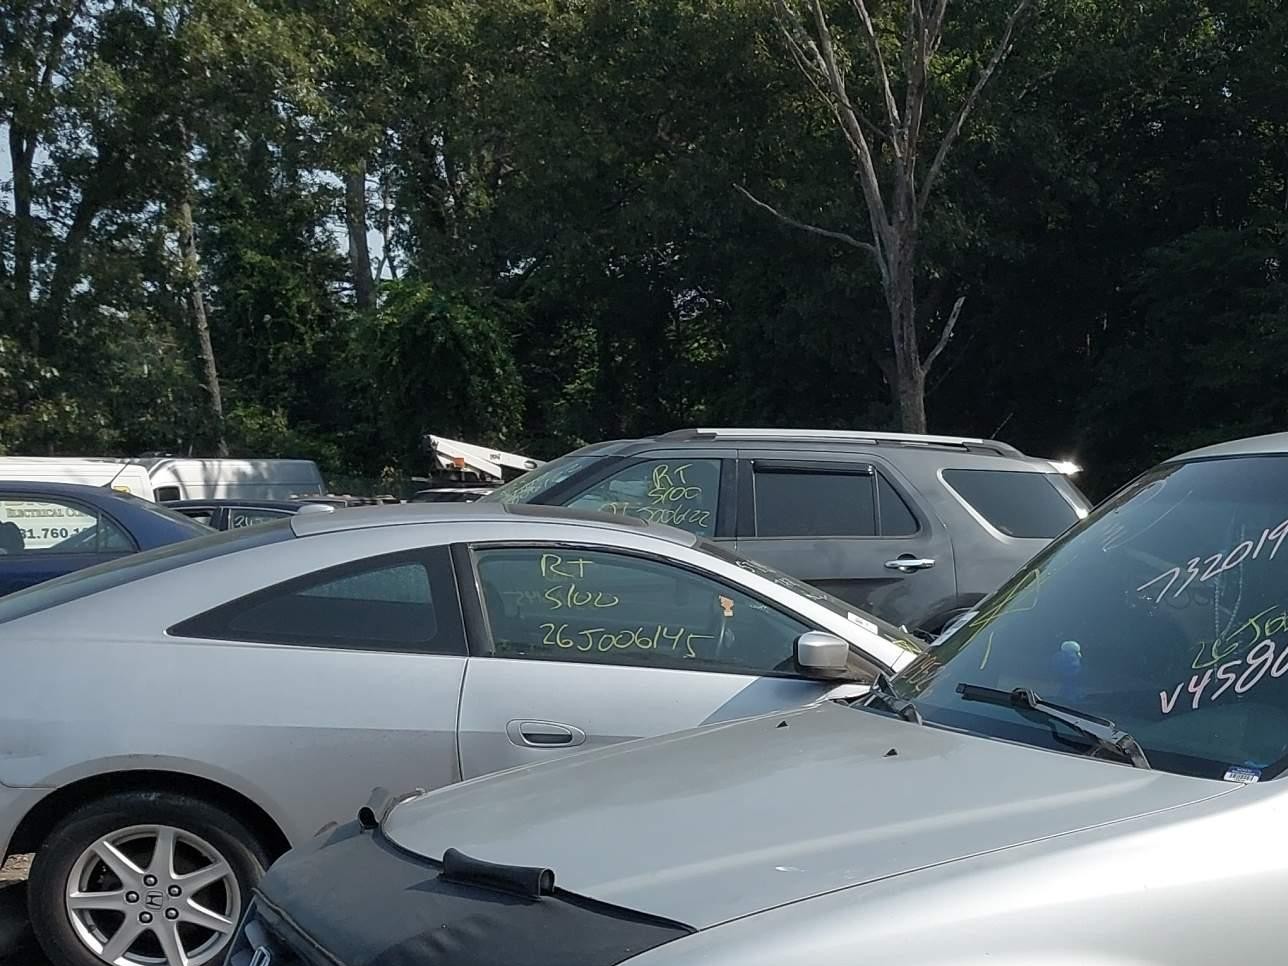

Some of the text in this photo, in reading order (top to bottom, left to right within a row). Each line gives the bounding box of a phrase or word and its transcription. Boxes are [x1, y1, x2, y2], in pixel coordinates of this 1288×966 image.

[652, 464, 692, 490] RT
[544, 583, 619, 610] S100
[539, 622, 715, 658] 26J006145
